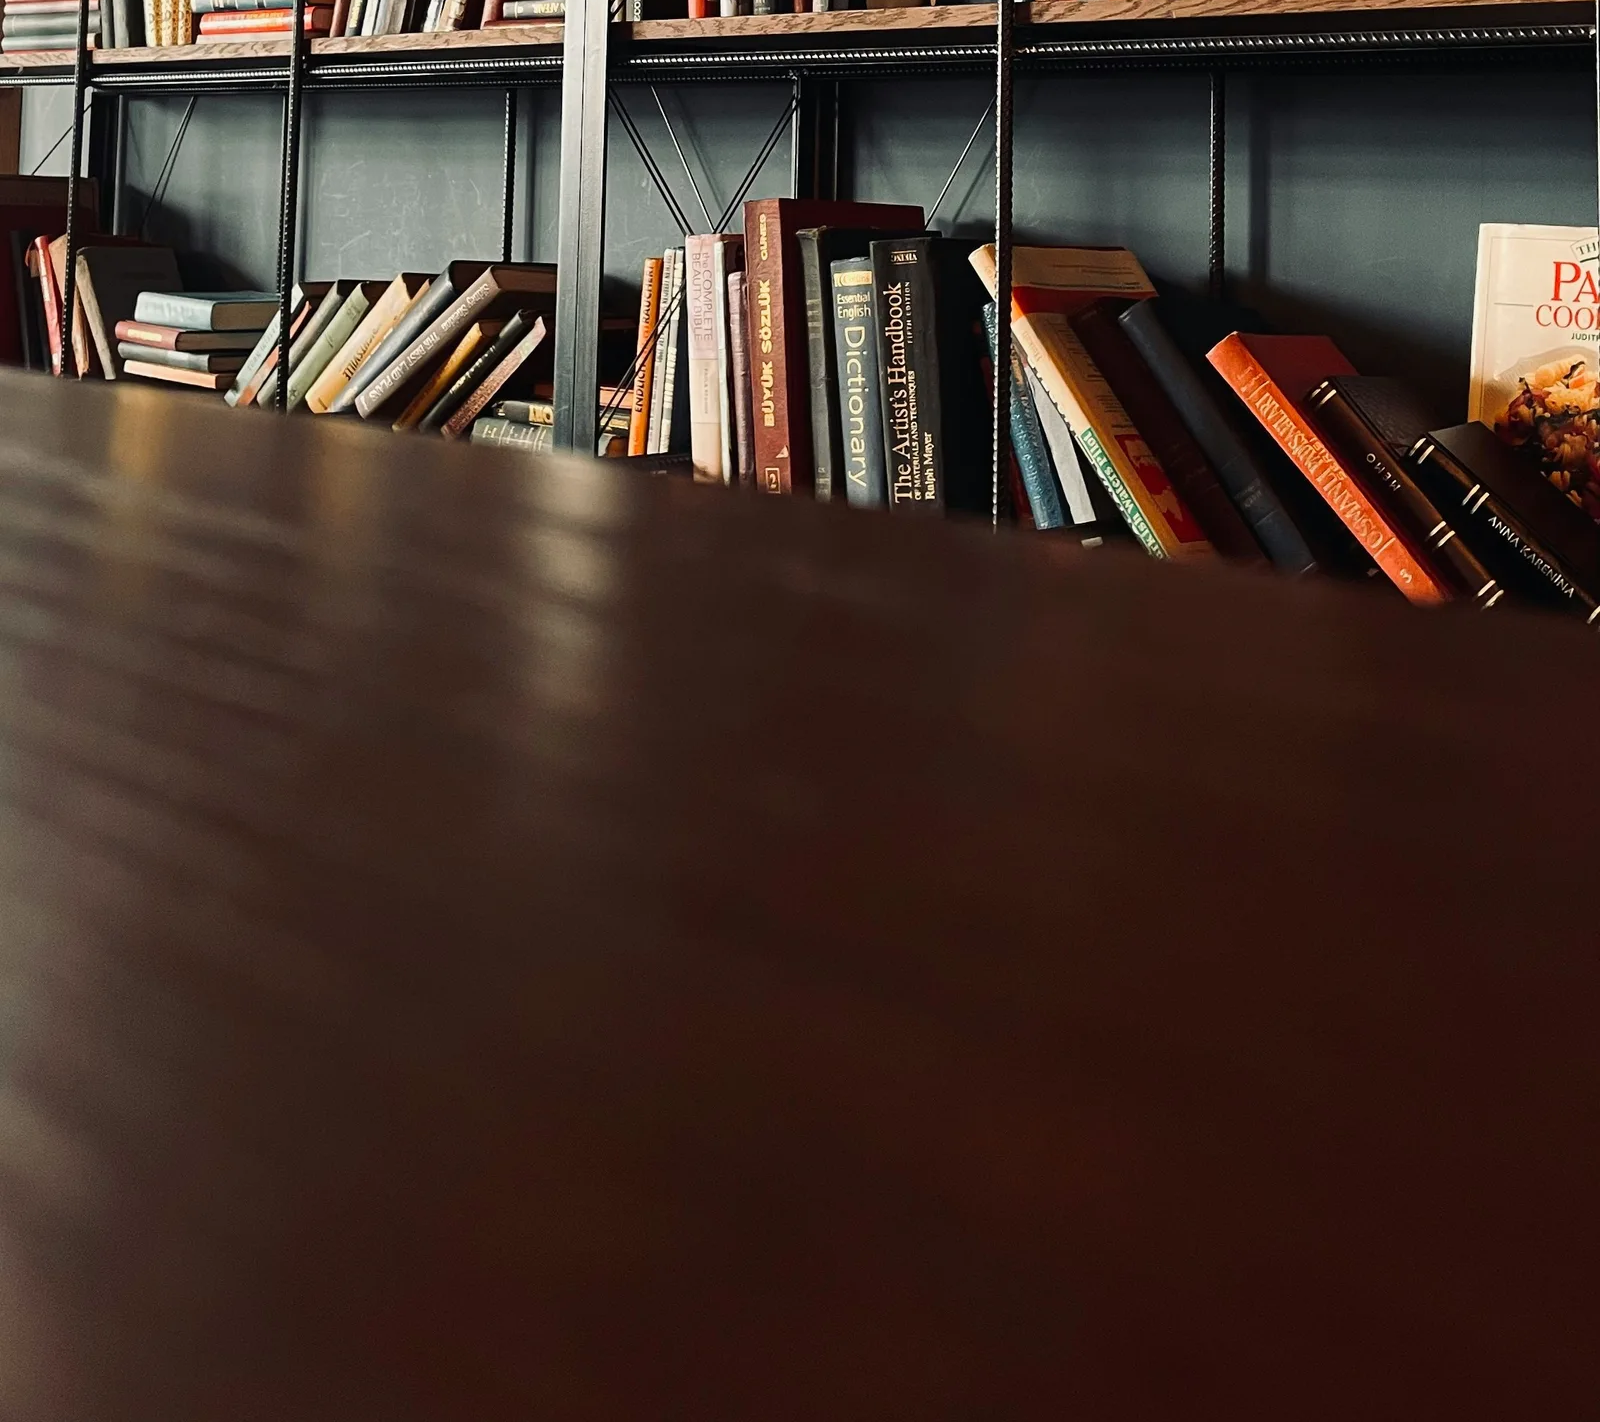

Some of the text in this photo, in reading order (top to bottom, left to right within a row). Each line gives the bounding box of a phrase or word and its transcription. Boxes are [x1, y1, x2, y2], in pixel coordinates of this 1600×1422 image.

[1576, 241, 1599, 256] TH
[464, 281, 490, 308] Sidney
[692, 253, 702, 342] BEAUTY BIBLE
[703, 269, 713, 342] COMPLETE
[837, 293, 871, 304] Essential
[1551, 260, 1600, 304] PA
[837, 305, 872, 320] English
[759, 279, 775, 427] BÜYÜK SÖZLÜK
[844, 325, 870, 487] Dictionary
[883, 282, 913, 504] The Artist's Handbook
[910, 418, 918, 442] AND
[911, 442, 921, 490] MATERIALS
[923, 431, 936, 501] Ralph Mayer
[1100, 464, 1137, 514] Waters
[1366, 453, 1401, 491] MEMO
[914, 490, 922, 501] OF
[1314, 467, 1385, 550] OSMANLI
[1129, 511, 1166, 561] urkish
[1488, 515, 1520, 548] ANNA
